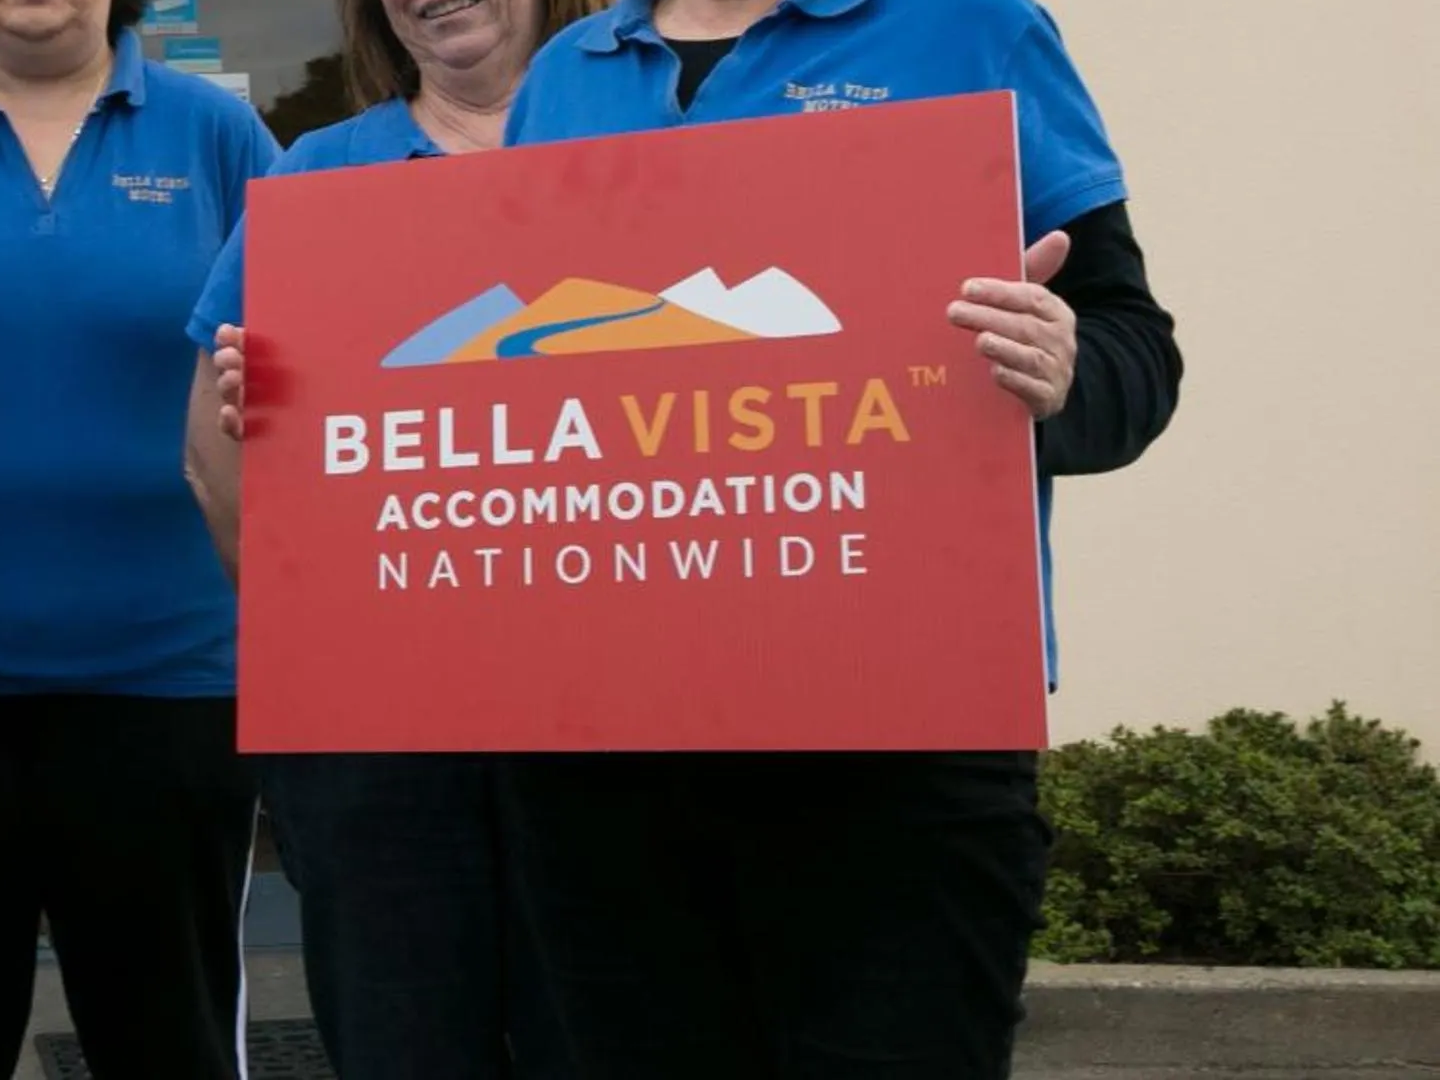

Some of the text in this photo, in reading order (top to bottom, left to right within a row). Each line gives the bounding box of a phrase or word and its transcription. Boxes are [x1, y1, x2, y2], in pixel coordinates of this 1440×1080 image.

[323, 397, 604, 475] BELLA
[620, 377, 912, 456] VISTA
[376, 471, 867, 531] ACCOMMODATION
[378, 533, 869, 590] NATIONWIDE
